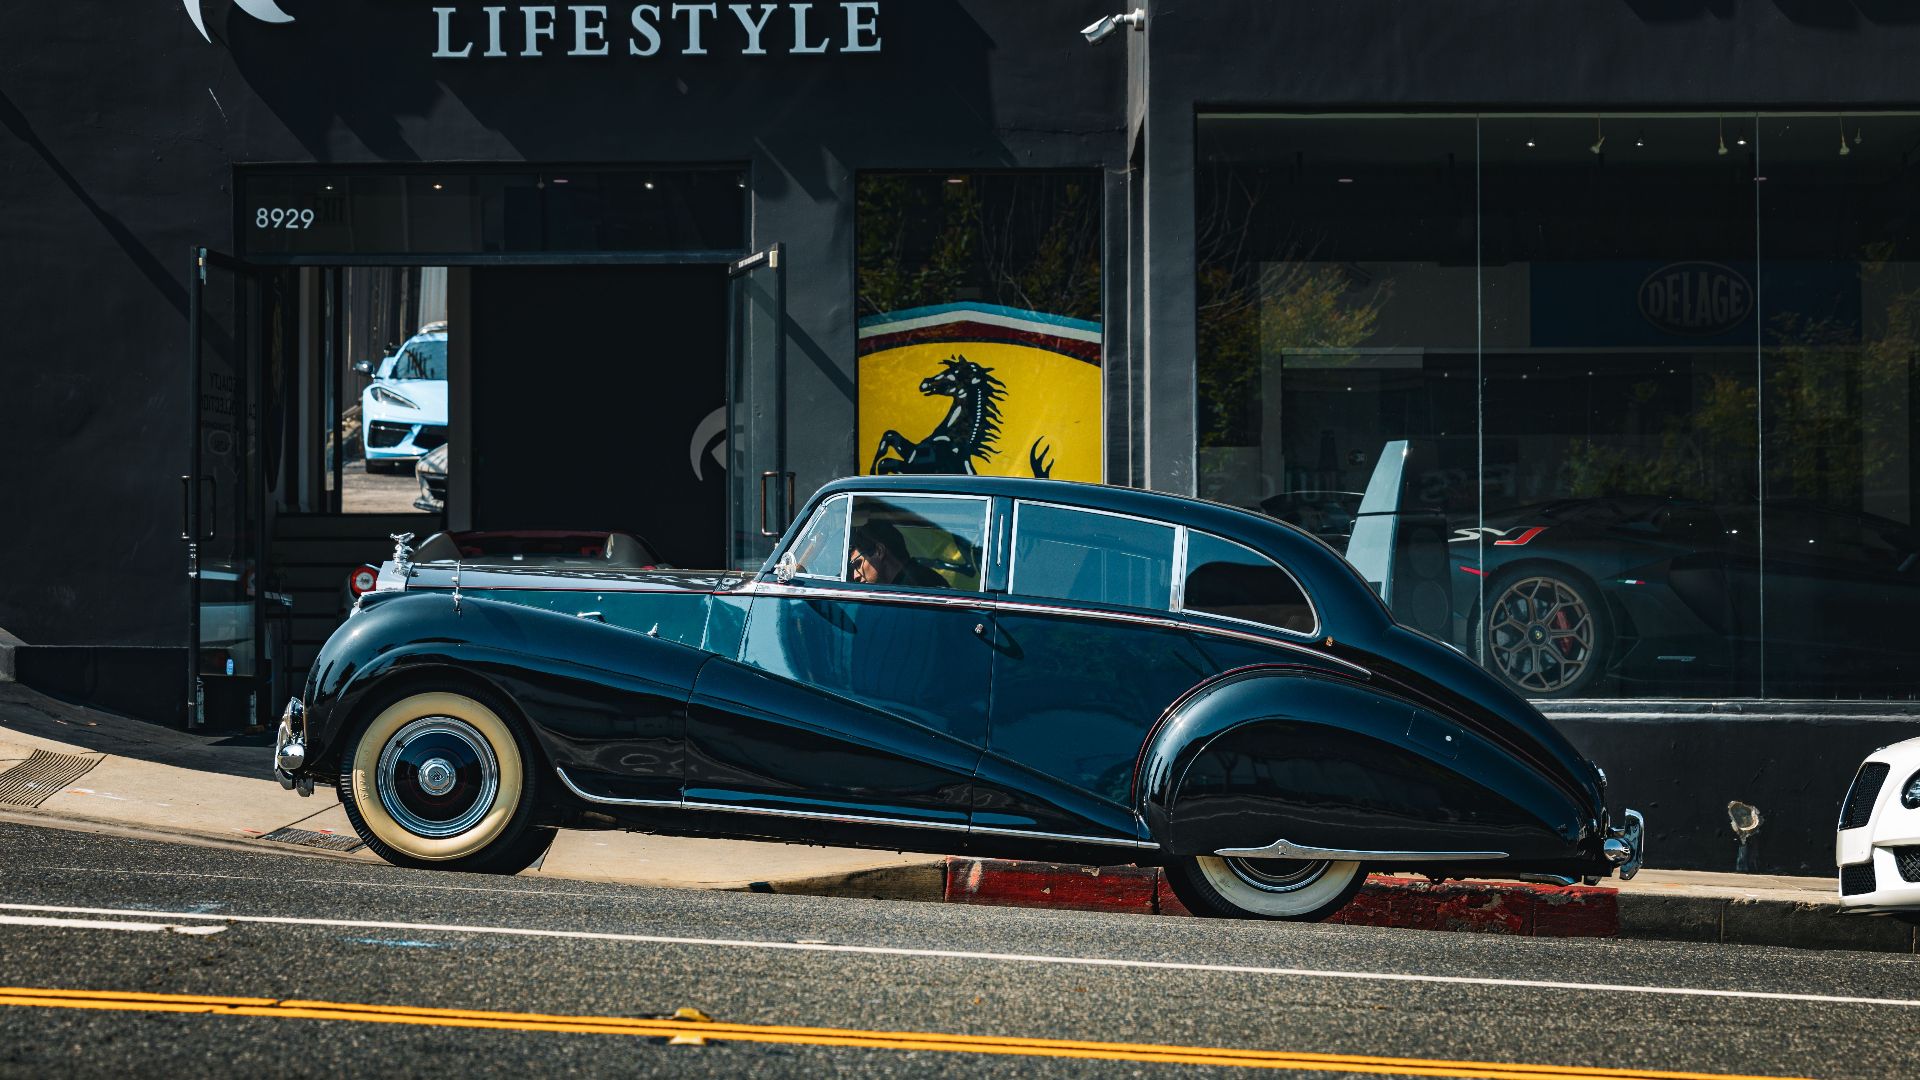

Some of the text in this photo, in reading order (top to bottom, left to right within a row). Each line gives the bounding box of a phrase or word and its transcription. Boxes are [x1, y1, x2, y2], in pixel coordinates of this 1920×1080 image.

[431, 1, 882, 58] LIFESTYLE
[255, 207, 315, 230] 8929
[1647, 271, 1744, 327] DELAGE
[1448, 525, 1550, 546] SVJ
